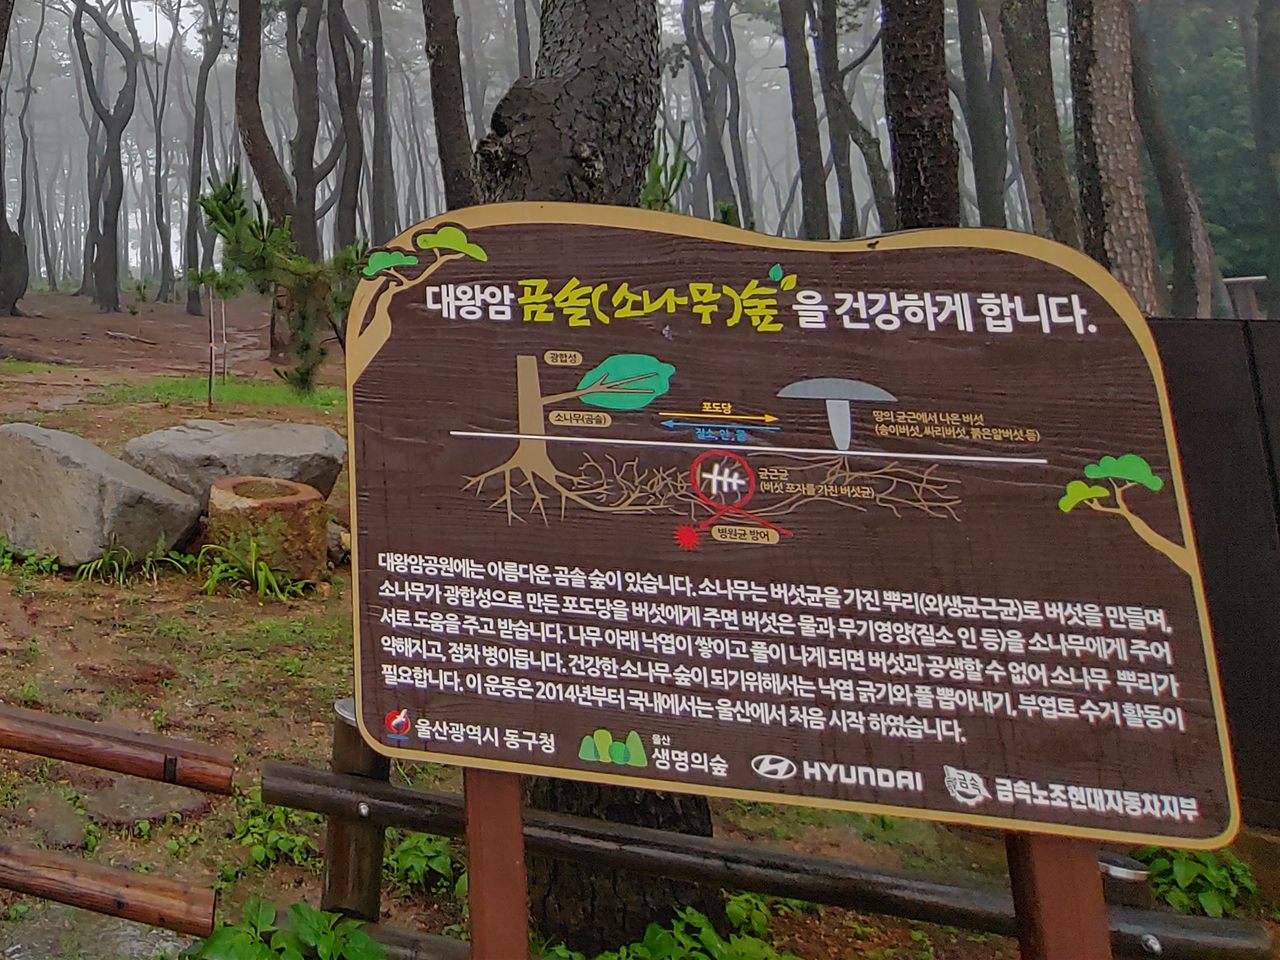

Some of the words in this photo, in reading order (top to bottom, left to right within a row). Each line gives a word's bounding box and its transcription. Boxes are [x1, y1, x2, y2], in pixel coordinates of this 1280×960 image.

[426, 284, 515, 321] 대왕암
[834, 291, 974, 333] 건강하게
[976, 293, 1098, 335] 합니다.
[550, 352, 577, 365] 광합성
[702, 401, 733, 414] 포도당
[717, 527, 748, 541] 병원균
[749, 529, 770, 542] 방어
[378, 552, 485, 580] 대왕암공원에는
[487, 560, 552, 585] 아름다운
[553, 566, 587, 588] 곰솔
[588, 568, 622, 591] 숲이
[625, 572, 697, 598] 있습니다.
[698, 577, 767, 603] 소나무는
[770, 583, 842, 607] 버섯균을
[844, 588, 881, 612] 가진
[1044, 602, 1103, 626] 버섯을
[1105, 606, 1172, 633] 만들며,
[379, 580, 442, 604] 소나무가
[444, 585, 525, 610] 광합성으로
[527, 592, 559, 615] 만든
[562, 596, 629, 621] 포도당을
[632, 602, 701, 628] 버섯에게
[703, 607, 738, 631] 주면
[742, 611, 796, 635] 버섯은
[798, 614, 835, 638] 물과
[958, 627, 977, 649] 인
[980, 627, 1025, 653] 등)을
[1029, 632, 1128, 661] 소나무에게
[1129, 639, 1172, 665] 주어
[380, 607, 413, 628] 서로
[414, 611, 461, 633] 도움을
[462, 615, 496, 636] 주고
[498, 618, 567, 644] 받습니다.
[569, 625, 603, 648] 나무
[605, 627, 639, 651] 아래
[641, 632, 692, 656] 낙엽이
[695, 637, 750, 660] 쌓이고
[750, 641, 787, 664] 풀이
[790, 645, 827, 668] 나게
[828, 648, 865, 671] 되면
[868, 650, 923, 676] 버섯과
[925, 655, 983, 682] 공생할
[985, 660, 1007, 683] 수
[1008, 661, 1048, 686] 없어
[1050, 665, 1110, 691] 소나무
[1116, 670, 1179, 697] 뿌리가
[380, 635, 447, 660] 약해지고,
[447, 642, 481, 665] 점차
[568, 654, 618, 679] 건강한
[620, 657, 672, 683] 소나무
[673, 664, 708, 688] 숲이
[818, 677, 854, 701] 낙엽
[856, 680, 912, 706] 긁기와
[914, 686, 935, 708] 풀
[936, 687, 1017, 717] 뽑아내기,
[1018, 693, 1079, 720] 부엽토
[1079, 700, 1121, 726] 수거
[1122, 702, 1185, 732] 활동이
[381, 664, 463, 692] 필요합니다.
[466, 672, 482, 694] 이
[484, 674, 534, 700] 운동은
[535, 680, 624, 710] 2014년부터
[626, 688, 714, 718] 국내에서는
[715, 697, 787, 726] 울산에서
[789, 705, 825, 729] 처음
[829, 709, 865, 733] 시작
[867, 712, 966, 743] 하였습니다.
[414, 718, 499, 747] 울산광역시
[503, 731, 555, 754] 동구청
[651, 733, 671, 746] 울산
[651, 748, 729, 777] 생명의숲
[803, 760, 923, 791] HYUNDAI
[994, 777, 1200, 822] 금속노조현대자동차지부
